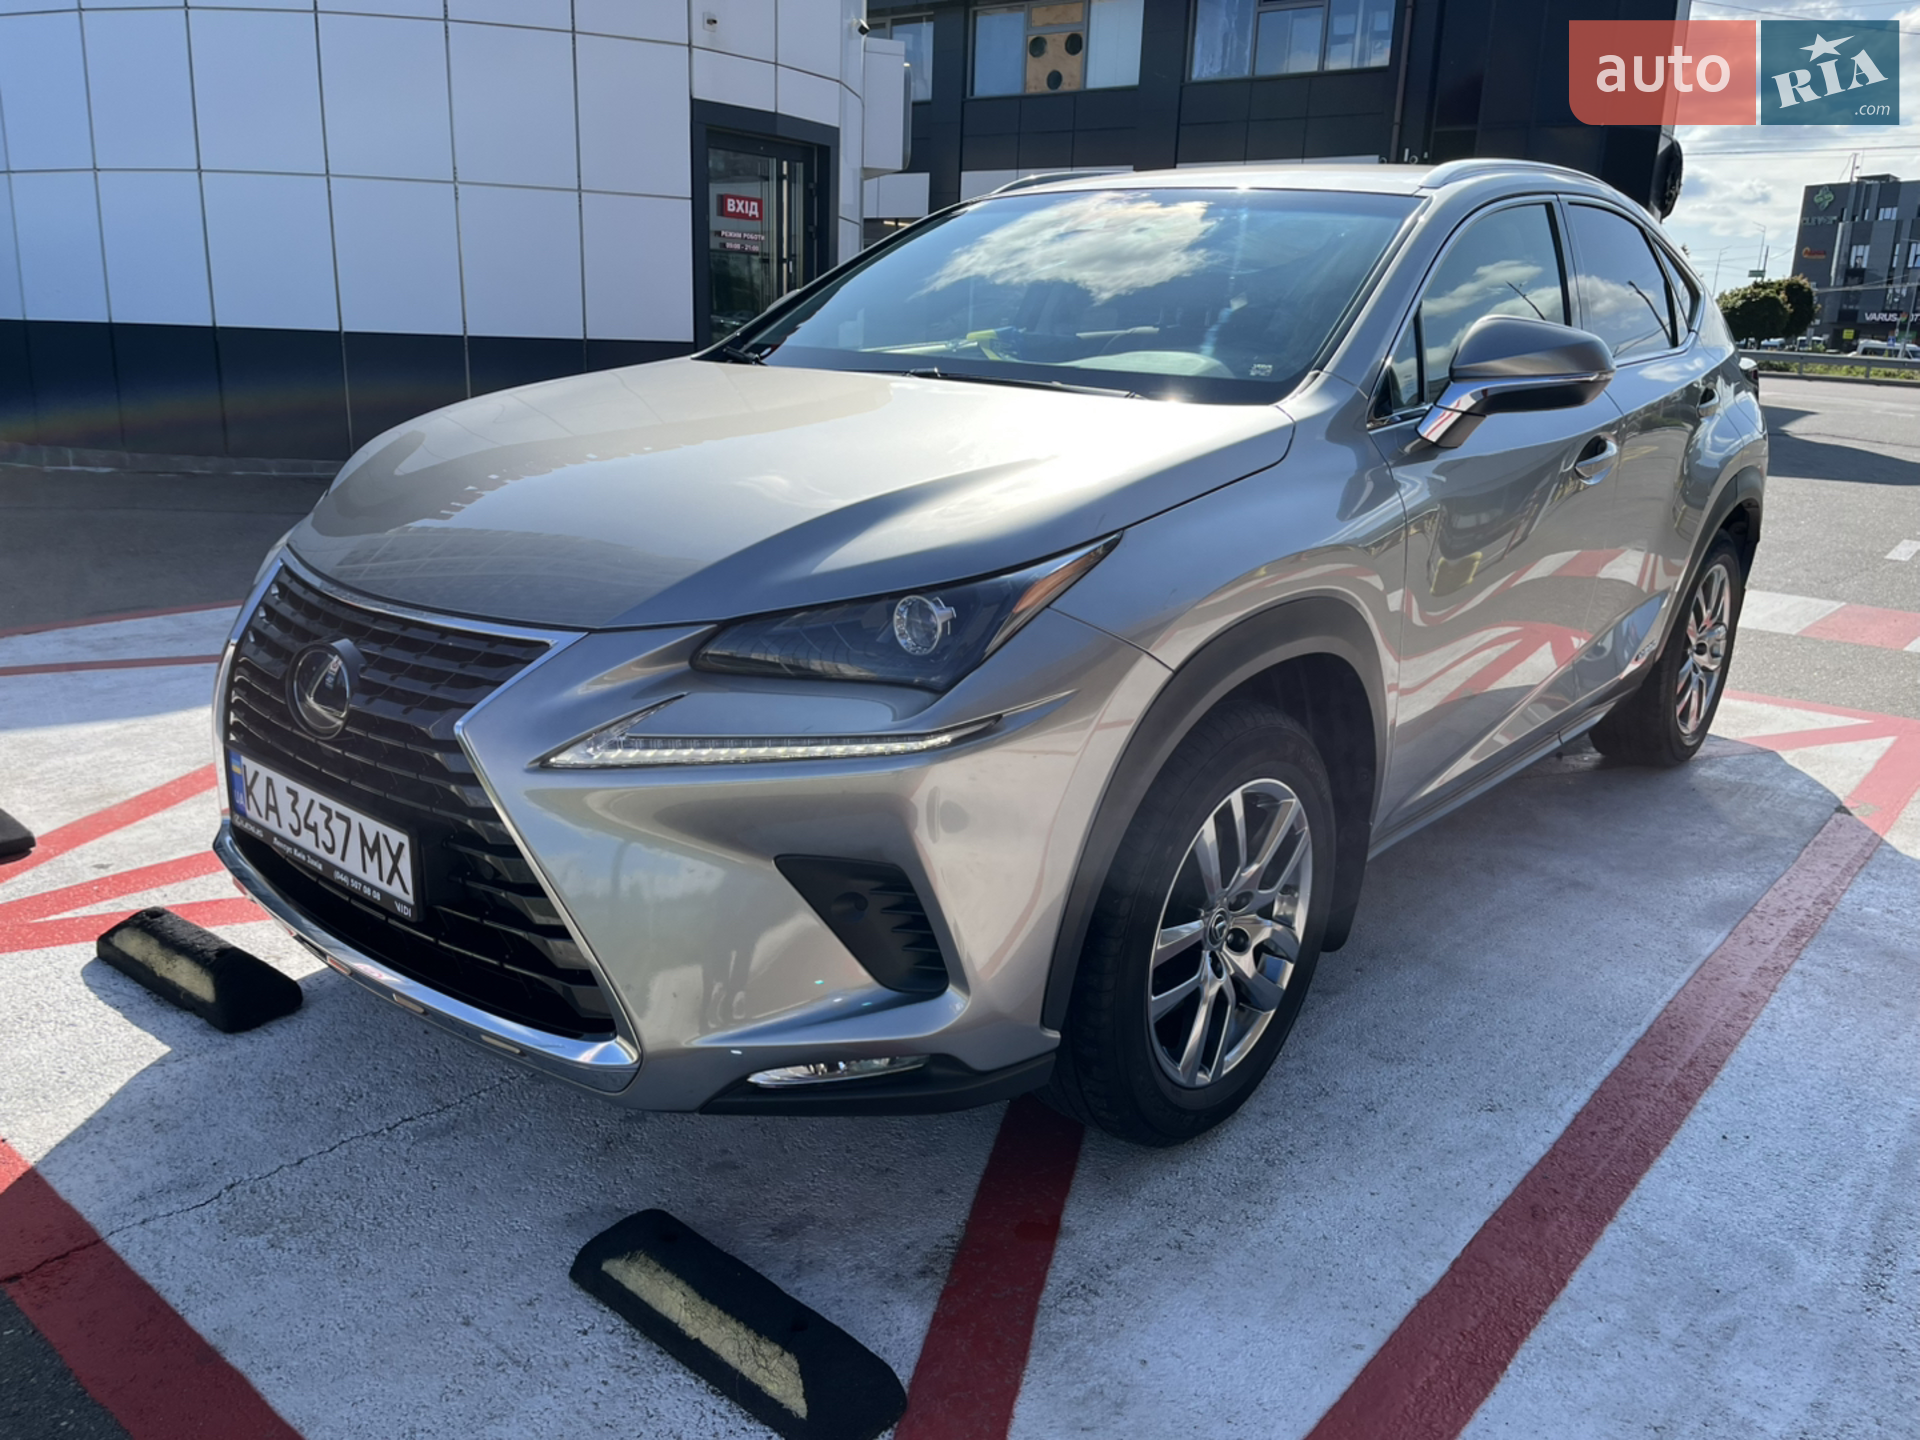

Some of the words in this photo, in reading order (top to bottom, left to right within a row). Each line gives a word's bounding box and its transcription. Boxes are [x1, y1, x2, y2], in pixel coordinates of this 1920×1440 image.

[727, 198, 759, 218] ВХІД
[721, 230, 741, 239] РЕЖИМ
[743, 232, 765, 241] РОБОТИ
[1864, 312, 1898, 322] VARUS
[234, 790, 245, 805] UA
[243, 764, 282, 829] KA
[286, 786, 351, 863] 3437
[358, 822, 410, 895] MX
[394, 901, 412, 918] VIDI
